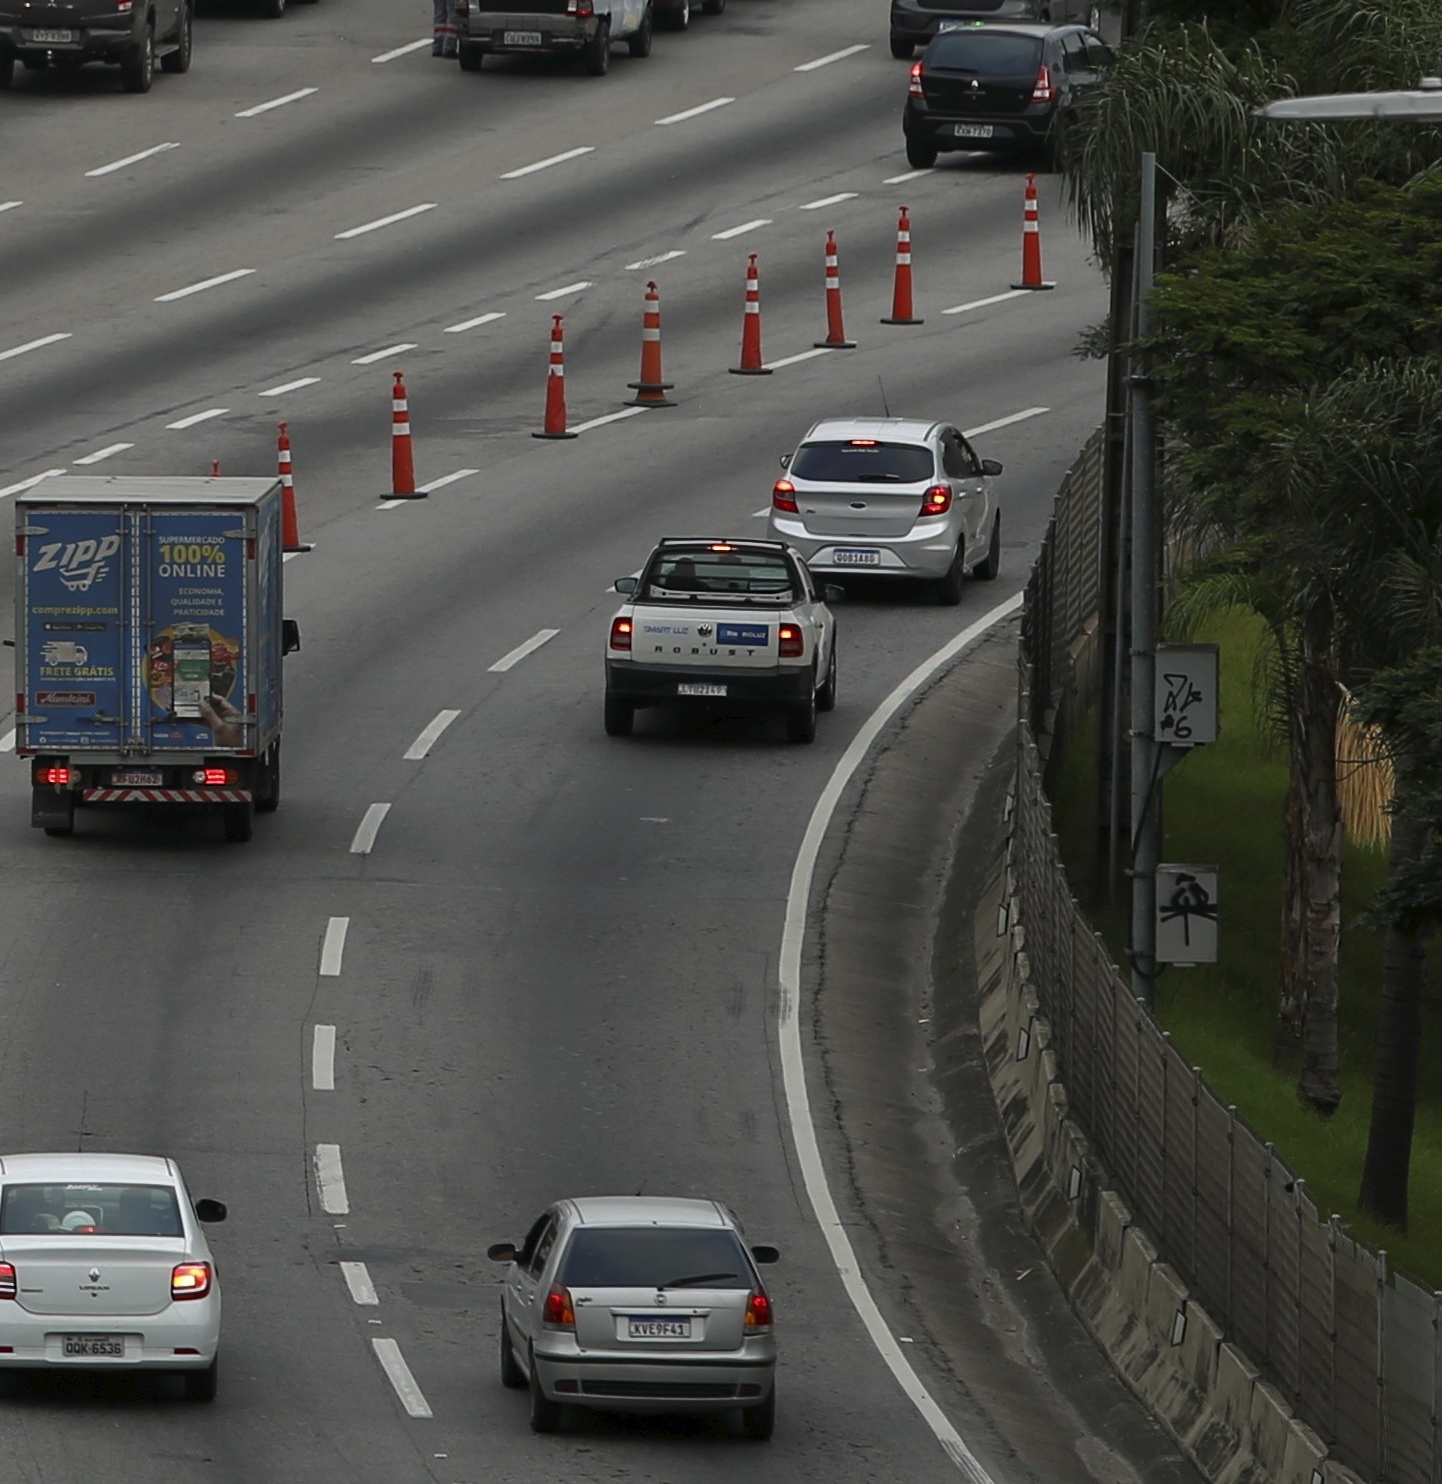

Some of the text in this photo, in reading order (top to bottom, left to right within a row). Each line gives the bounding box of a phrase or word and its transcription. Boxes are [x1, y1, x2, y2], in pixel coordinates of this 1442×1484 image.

[159, 536, 226, 544] SUPERMERCADO
[33, 535, 121, 572] ZIPP
[160, 544, 226, 564] 100%
[159, 564, 226, 577] ONLINE
[171, 598, 215, 606] QUALIDADE
[32, 605, 119, 616] comprezipp.com
[174, 608, 225, 616] PRATICIDADE
[673, 626, 689, 635] LUZ
[654, 646, 755, 656] ROBUST
[40, 665, 113, 676] FRETE GRÁTIS
[634, 1323, 685, 1336] KVE9F41
